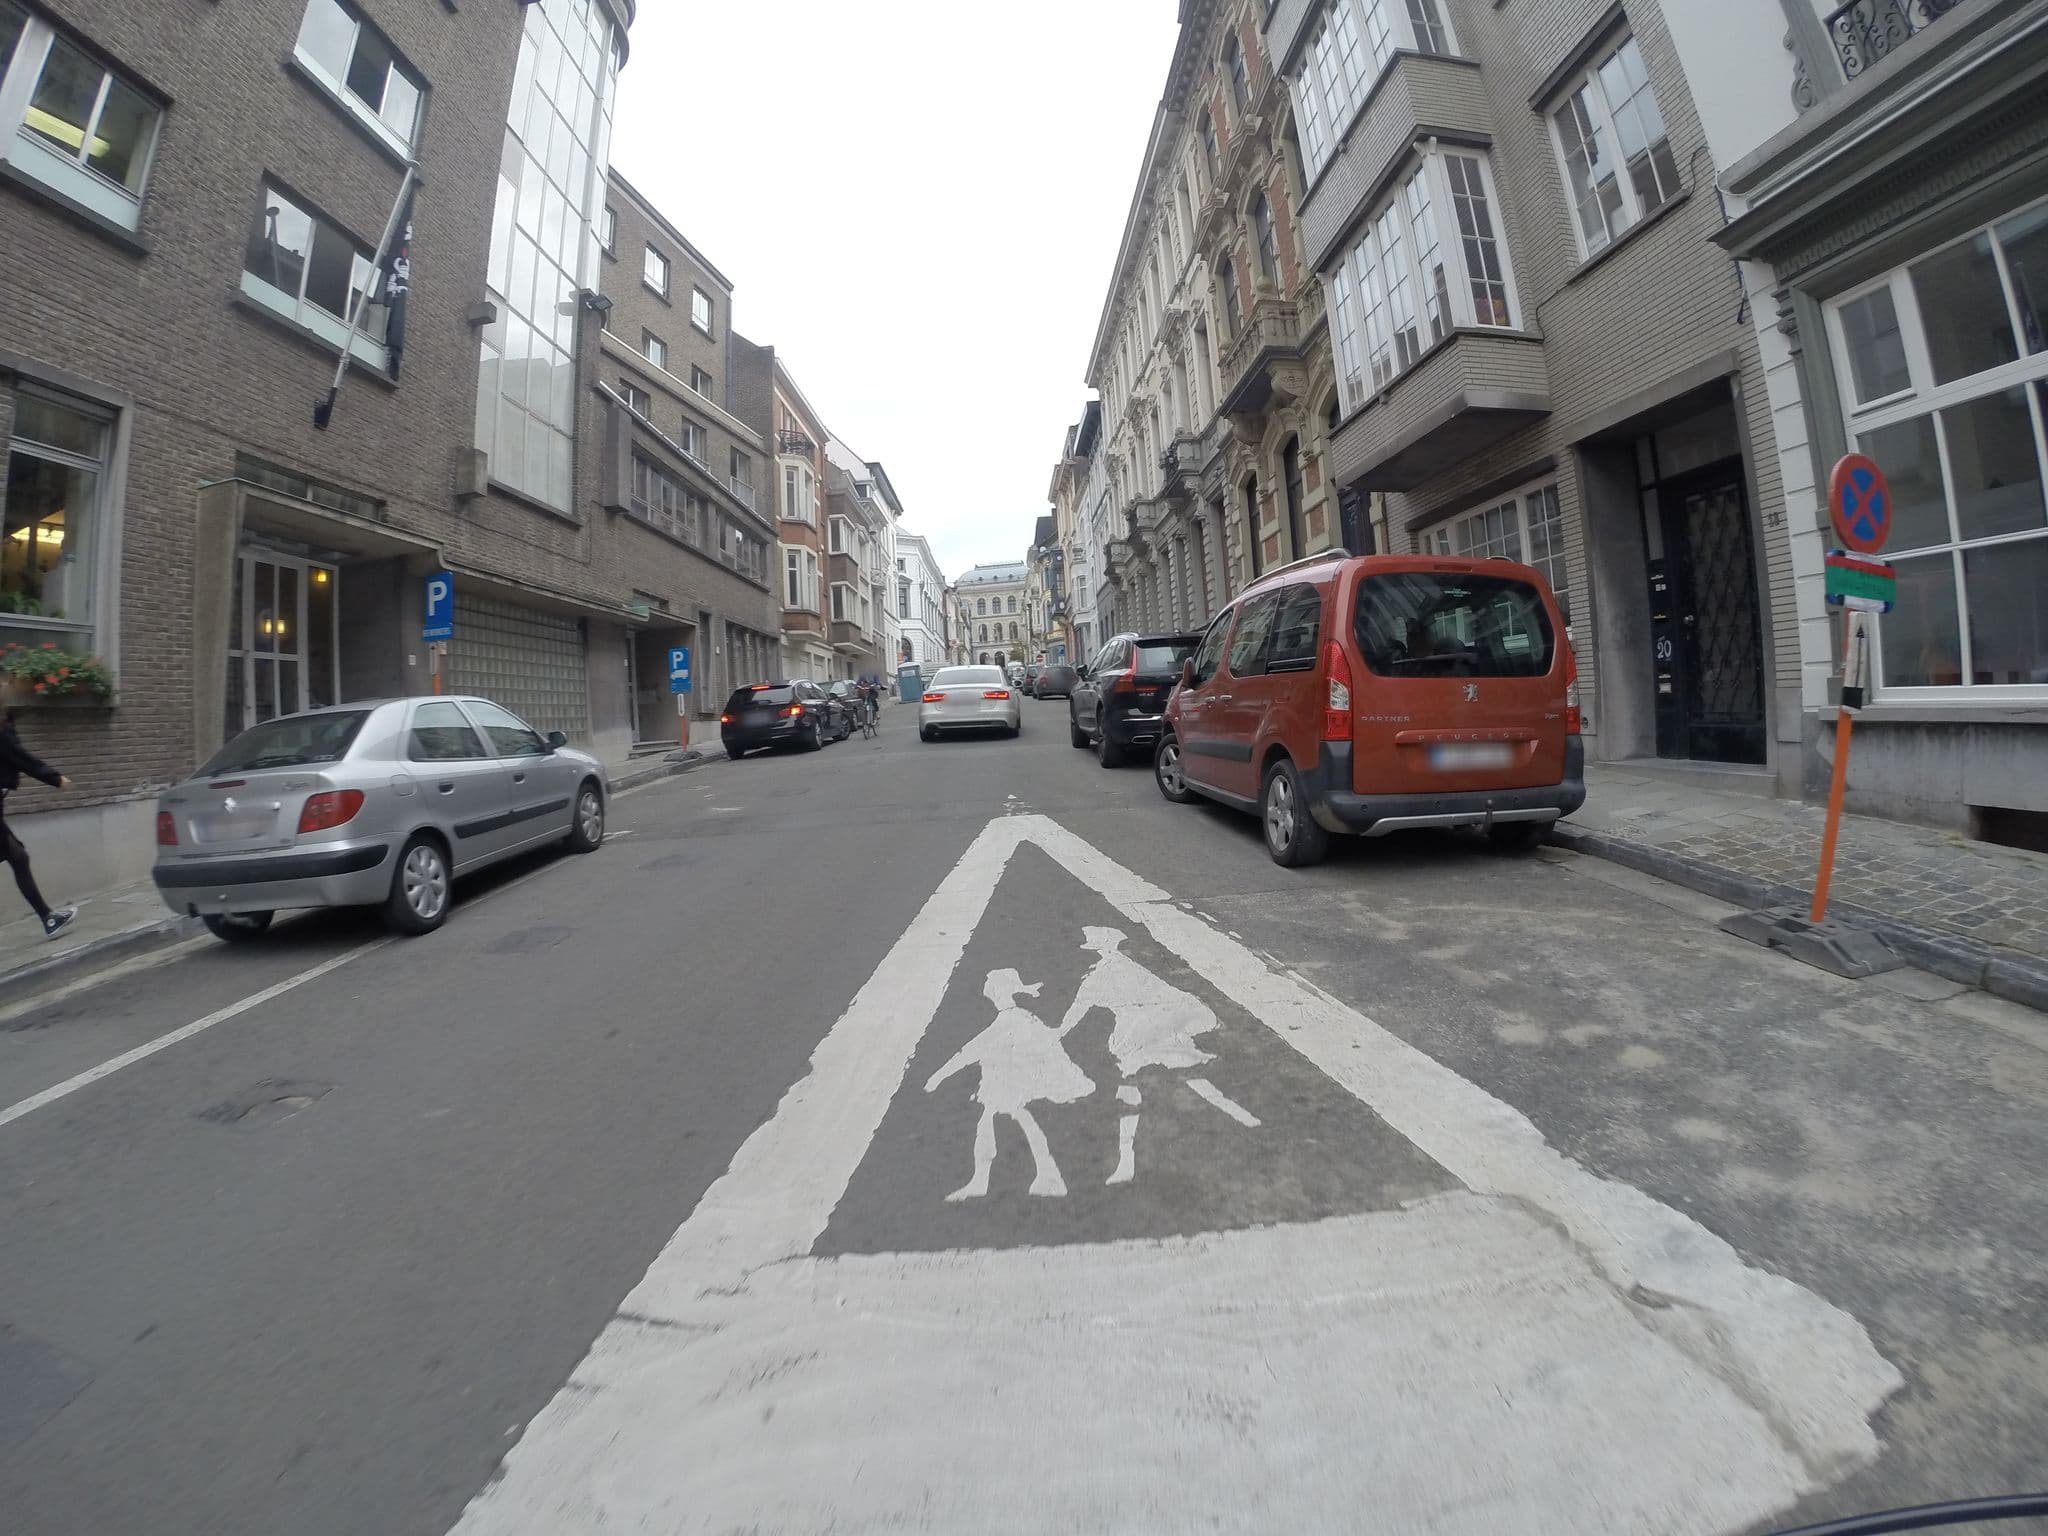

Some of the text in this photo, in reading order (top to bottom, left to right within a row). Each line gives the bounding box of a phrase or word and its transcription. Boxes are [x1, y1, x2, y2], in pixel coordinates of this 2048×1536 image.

[428, 581, 448, 617] P
[1657, 640, 1672, 659] 20
[672, 651, 684, 670] P
